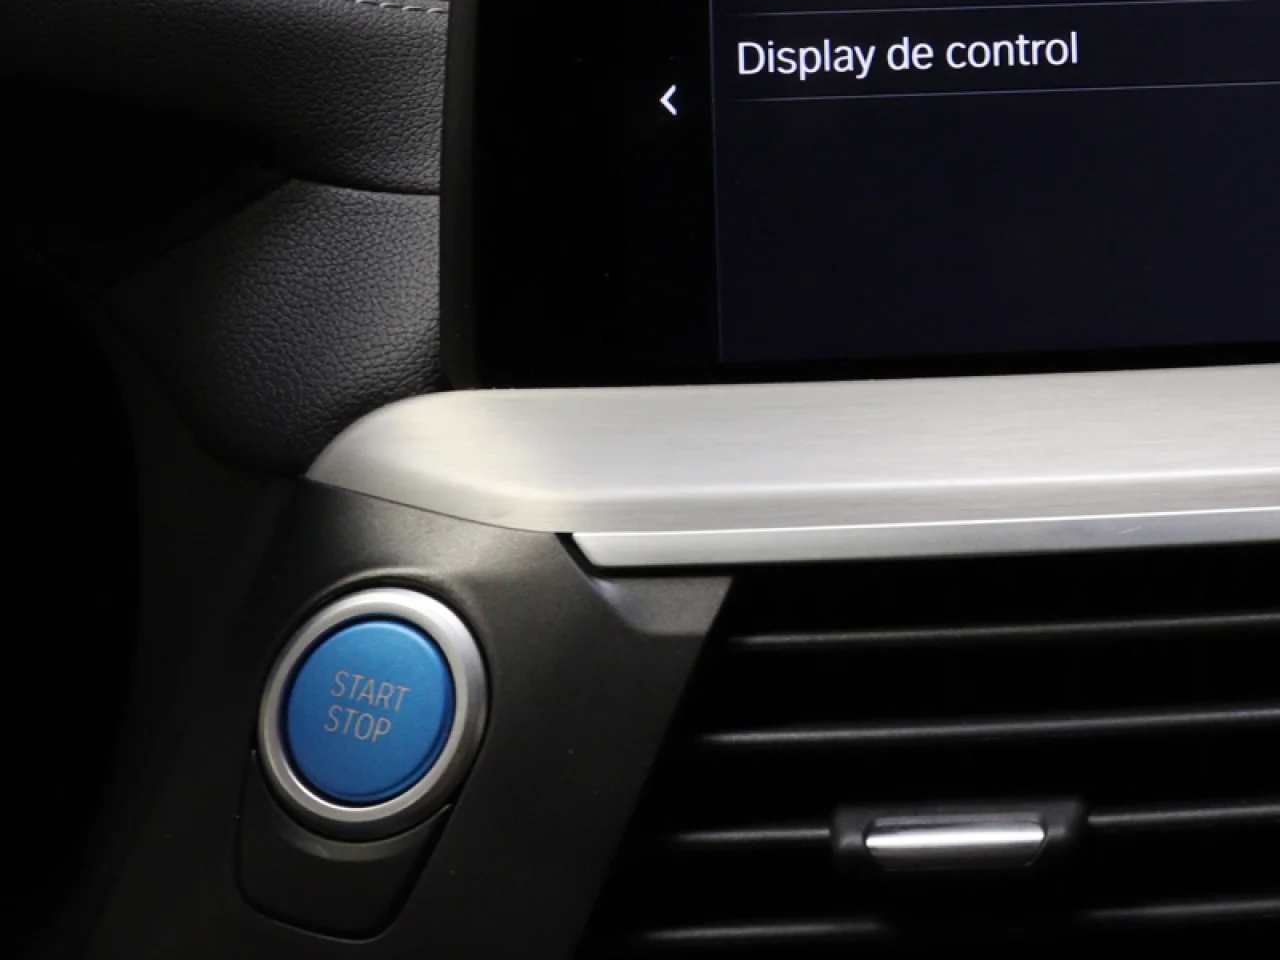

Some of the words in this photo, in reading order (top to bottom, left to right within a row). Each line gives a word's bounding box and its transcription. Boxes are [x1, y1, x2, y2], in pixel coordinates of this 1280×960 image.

[737, 38, 877, 81] Display
[886, 36, 935, 72] de
[945, 30, 1080, 70] control
[329, 670, 411, 713] START
[323, 705, 392, 744] STOP
